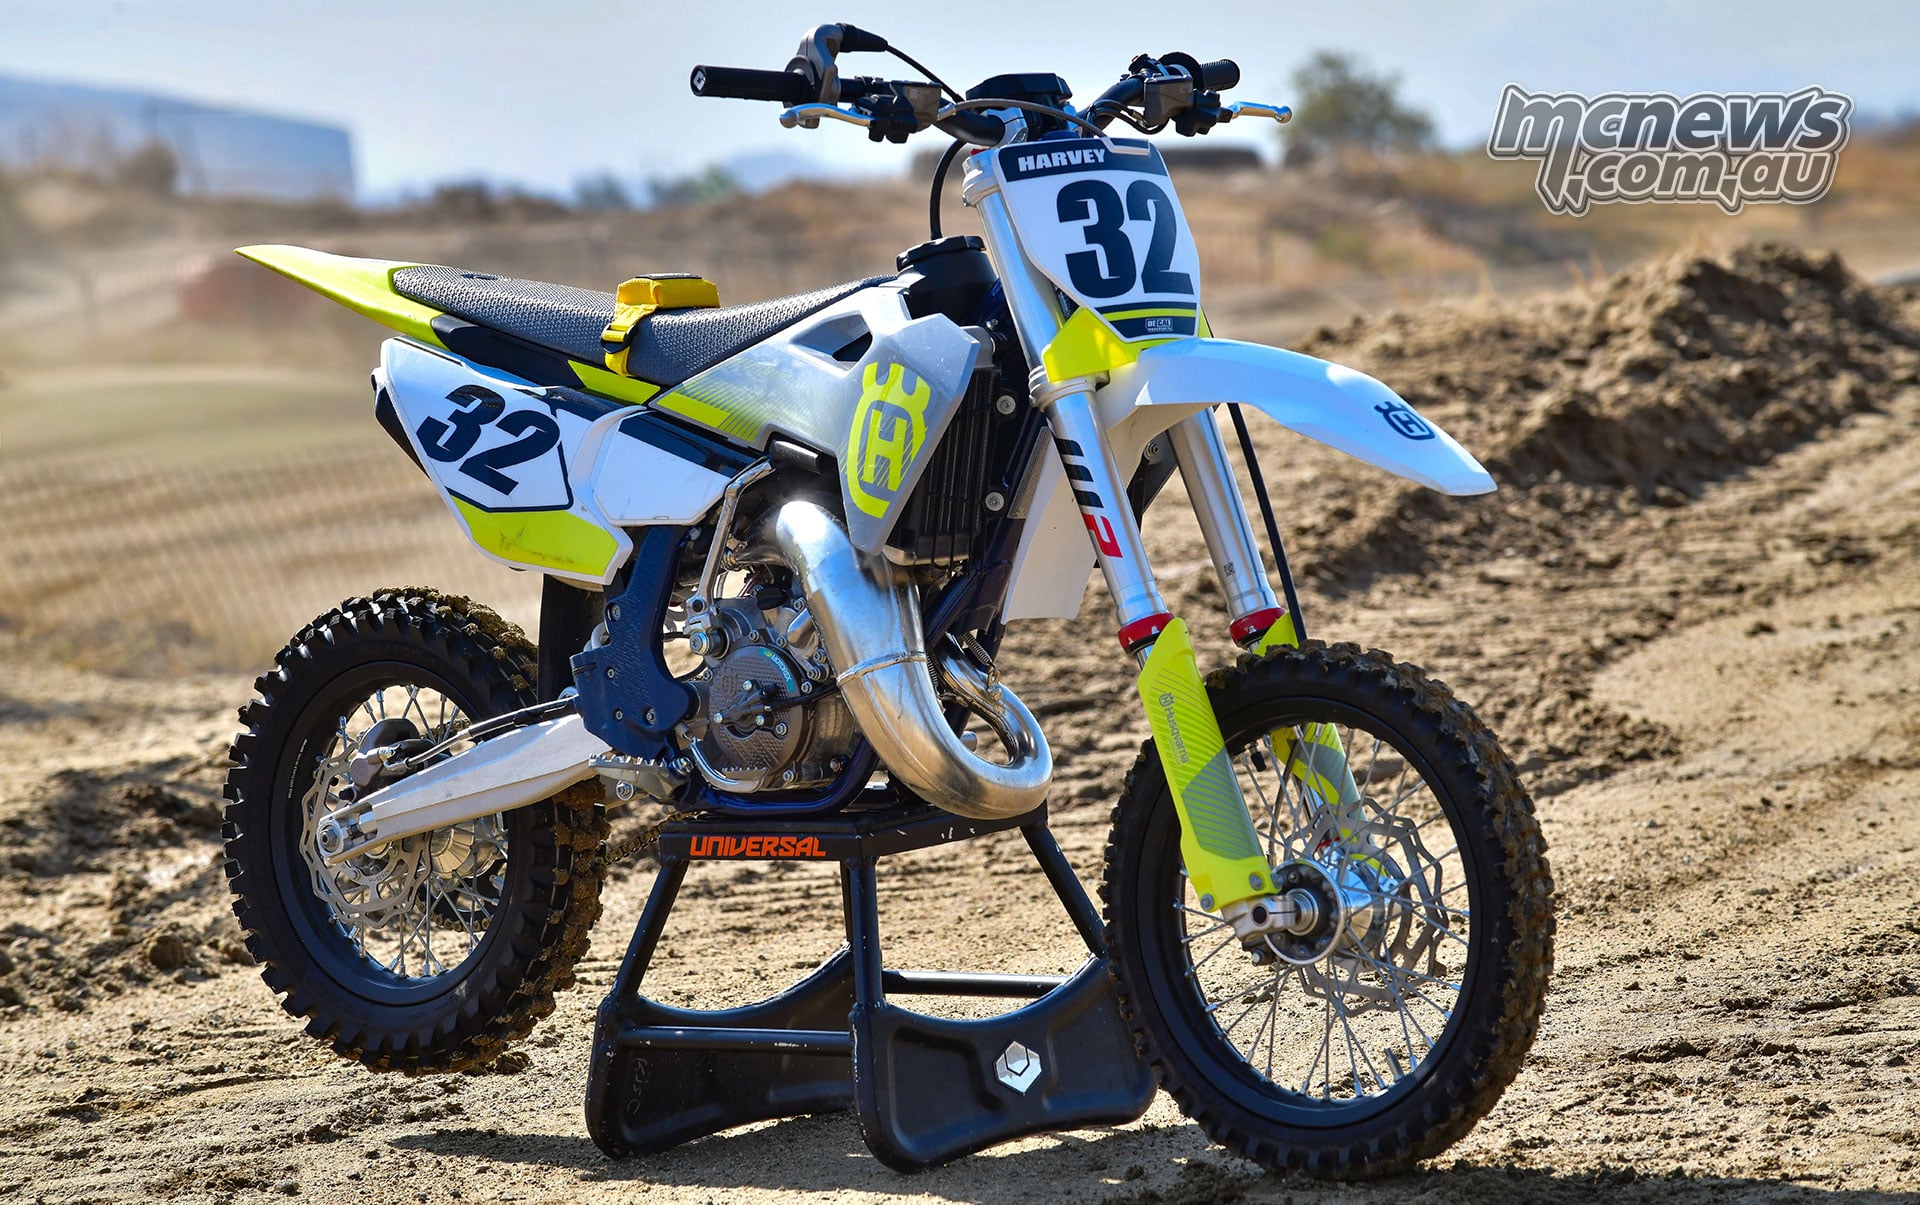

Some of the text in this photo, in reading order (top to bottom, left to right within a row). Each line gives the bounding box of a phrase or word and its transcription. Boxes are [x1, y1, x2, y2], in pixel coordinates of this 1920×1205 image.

[1018, 148, 1106, 172] HARVEY
[1056, 179, 1195, 299] 32
[416, 384, 561, 496] 32
[770, 654, 792, 682] MOTOREX
[1164, 706, 1190, 763] Husqvarna
[689, 835, 827, 857] UNIVERSAL
